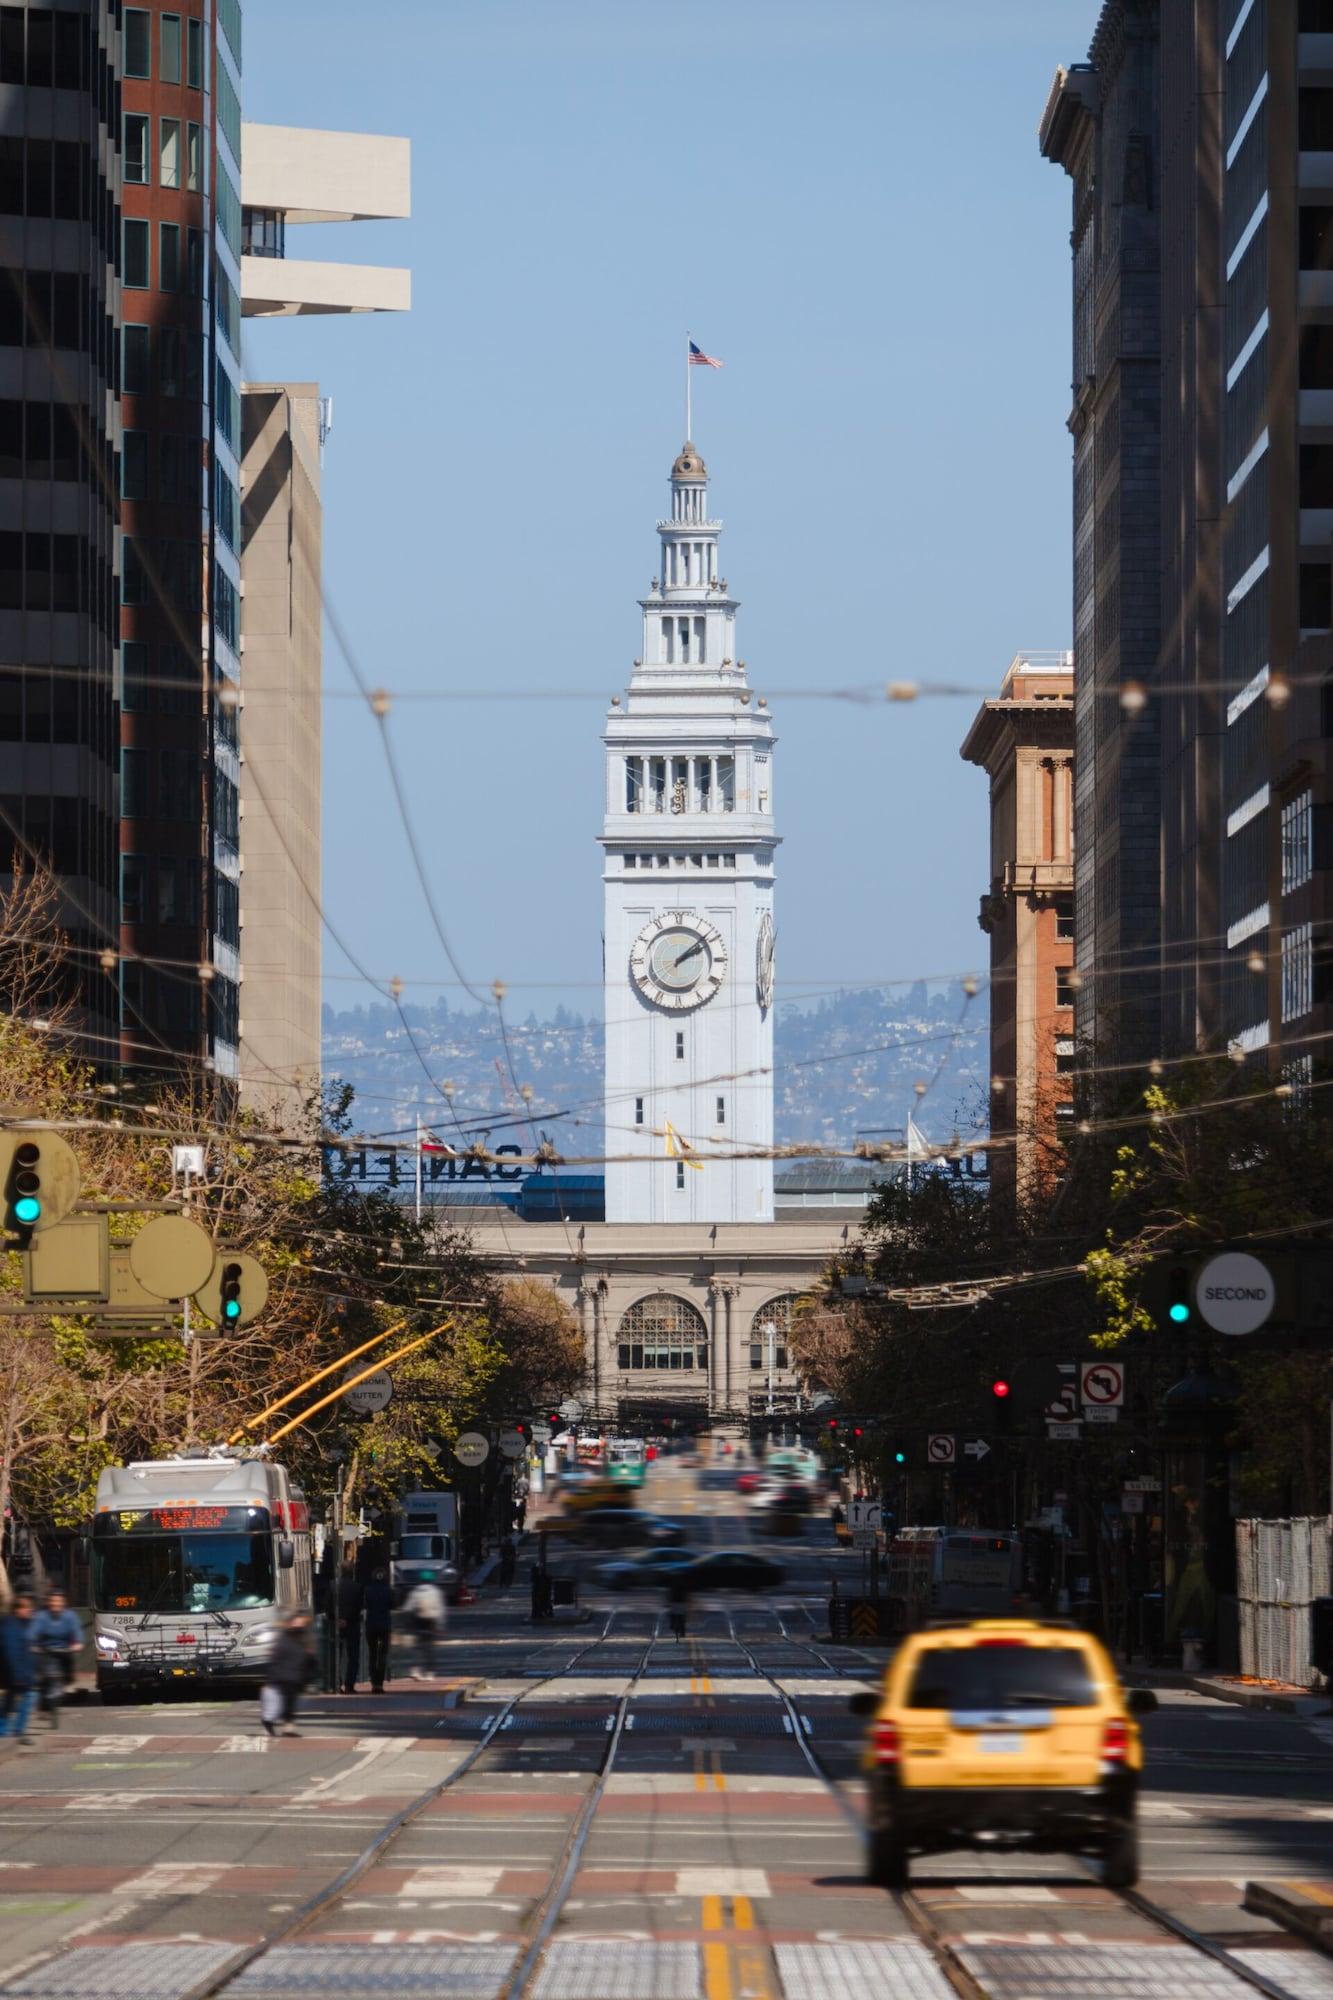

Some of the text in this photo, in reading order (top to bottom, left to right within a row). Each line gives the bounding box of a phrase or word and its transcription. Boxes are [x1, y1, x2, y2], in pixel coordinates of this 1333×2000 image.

[1205, 1287, 1266, 1301] SECOND
[351, 1391, 383, 1400] SUTTER
[115, 1595, 137, 1607] 357
[112, 1616, 135, 1625] 7288
